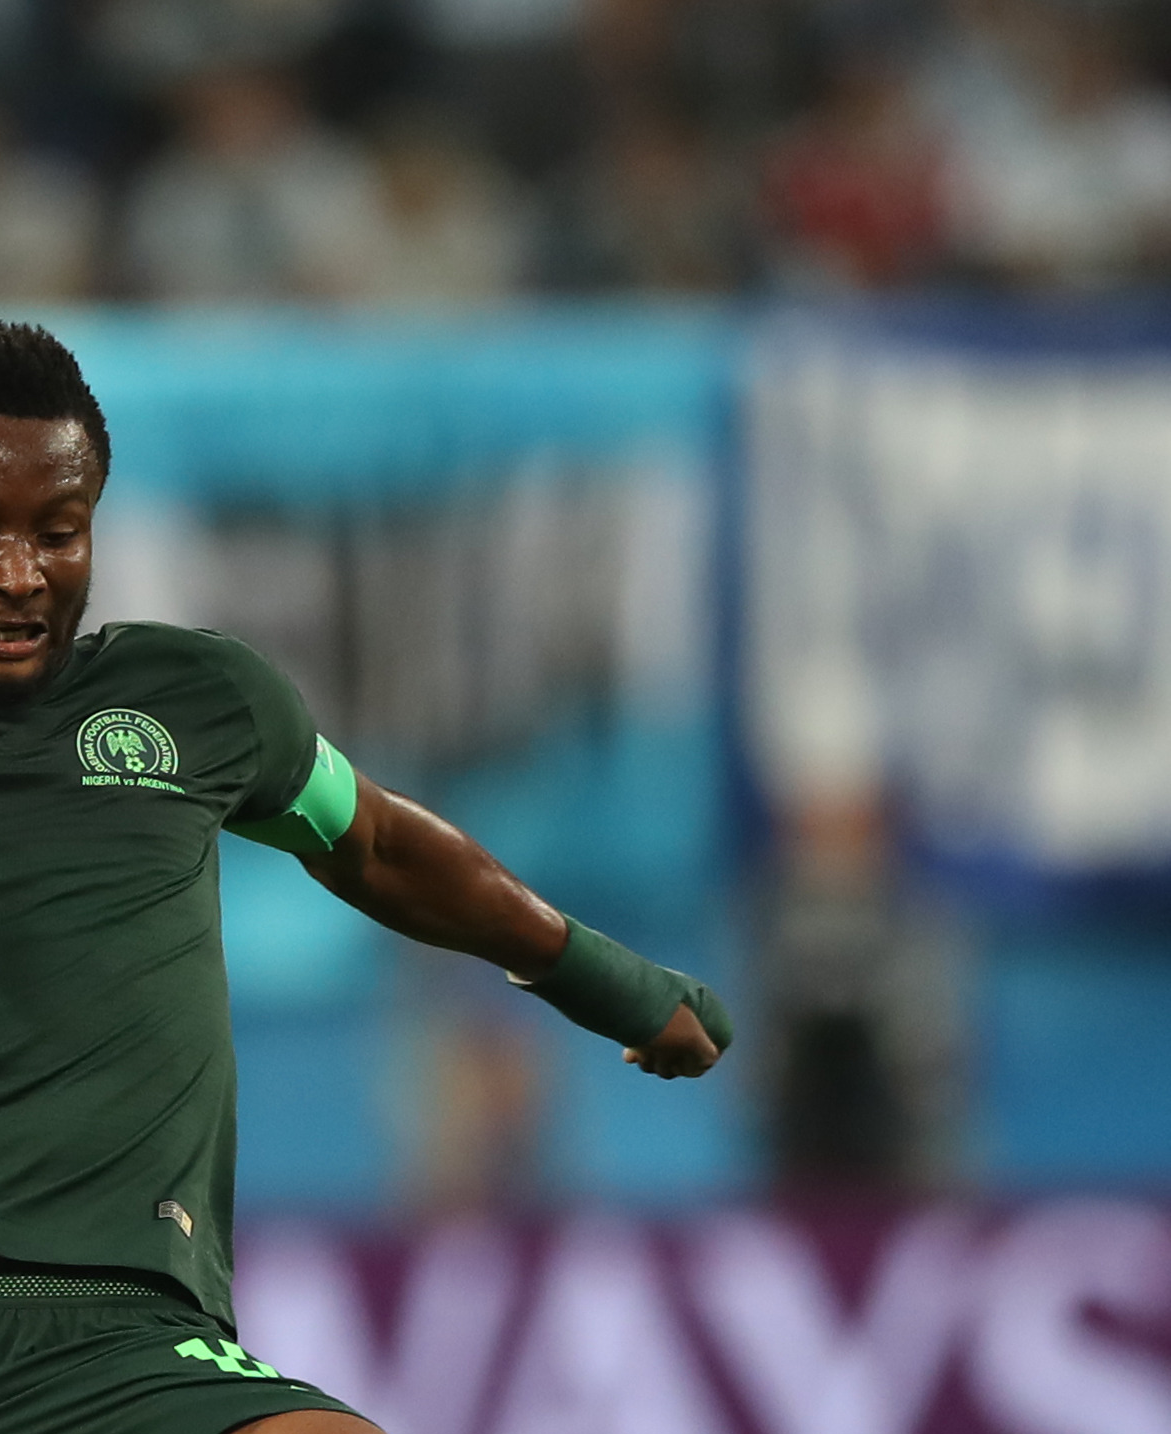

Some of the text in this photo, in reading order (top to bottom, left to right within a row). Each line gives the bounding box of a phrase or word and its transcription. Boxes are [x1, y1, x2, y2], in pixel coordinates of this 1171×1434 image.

[85, 713, 132, 742] FOOTBALL
[134, 716, 171, 774] FEDERATION
[81, 774, 122, 787] NIGERIA
[123, 778, 136, 787] vs
